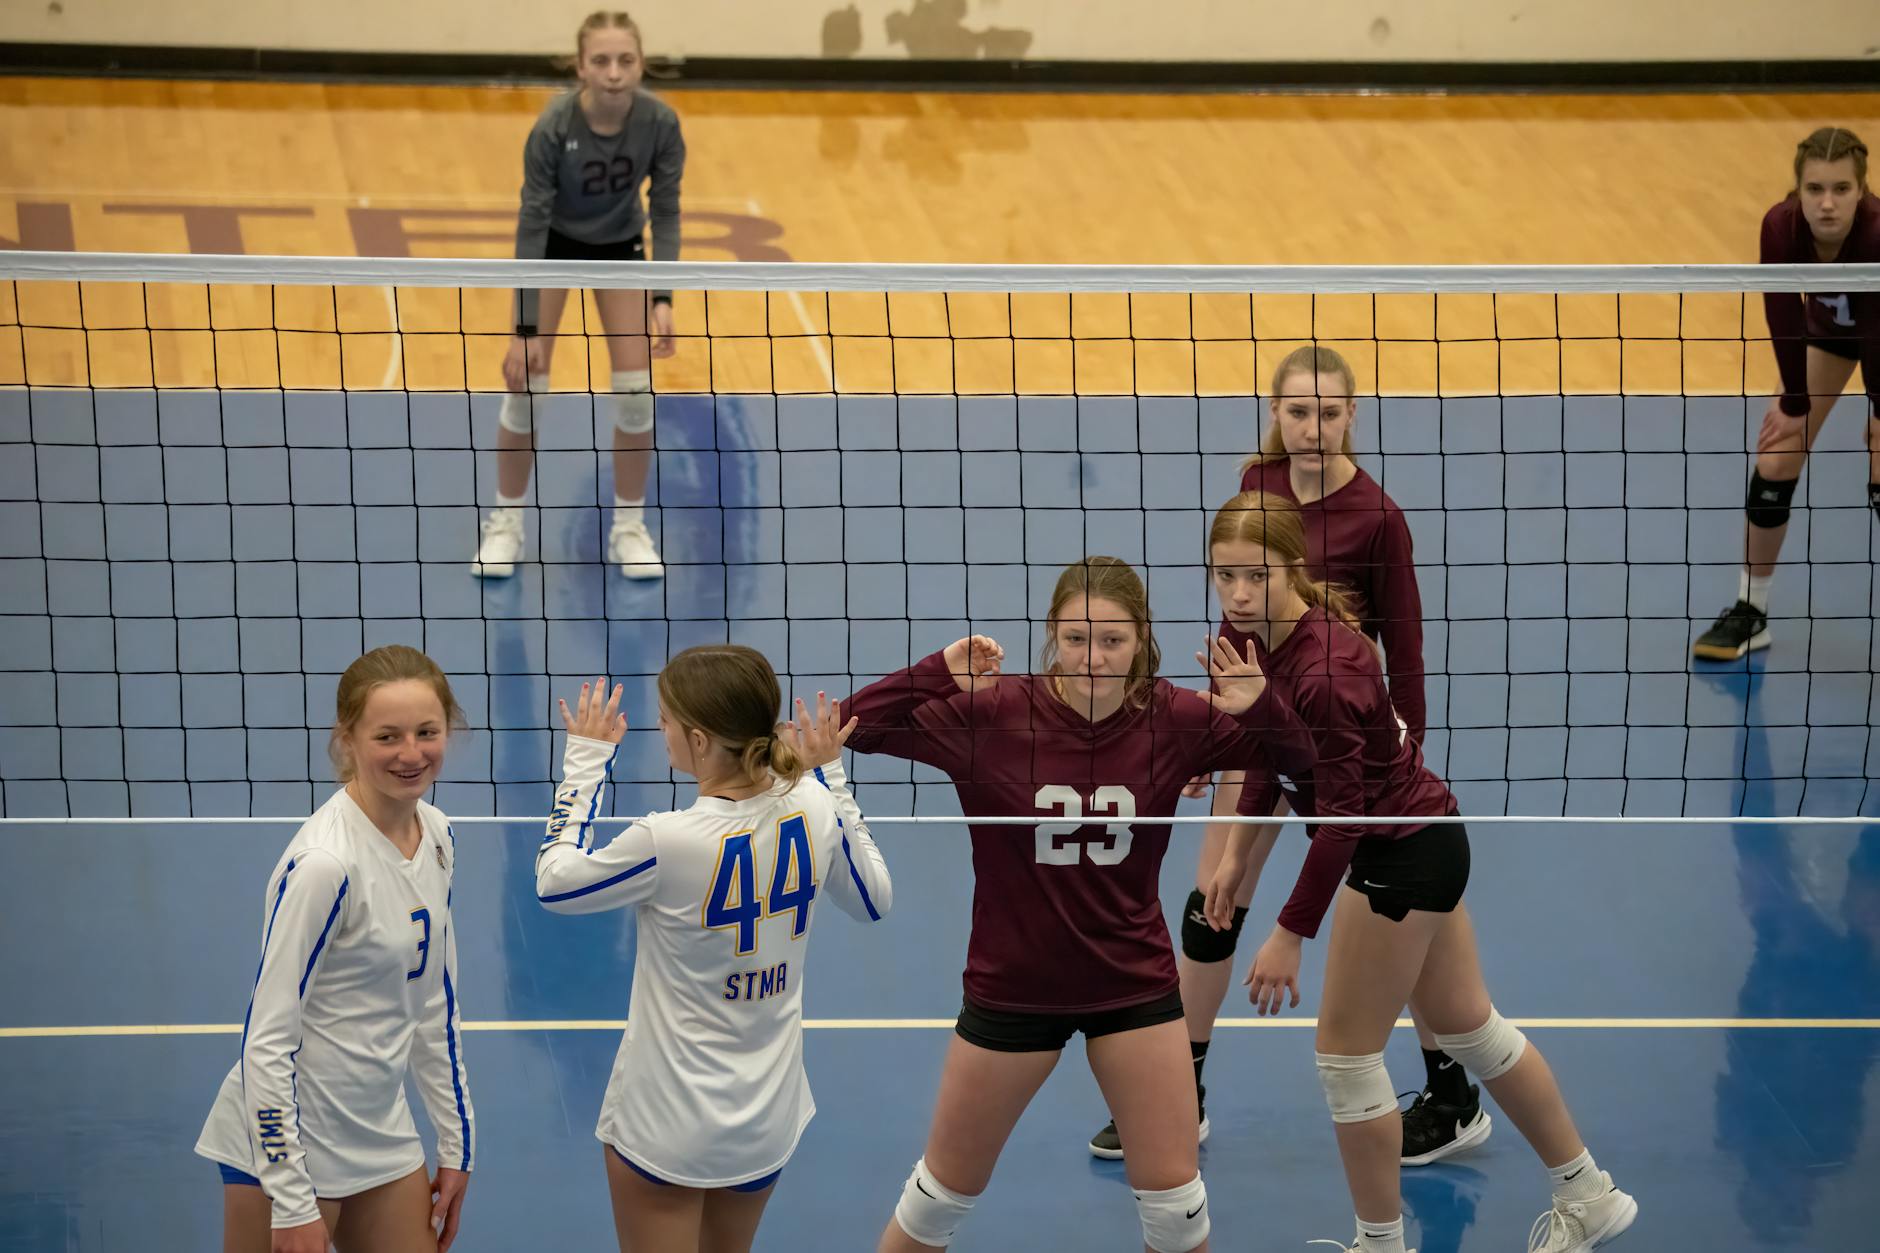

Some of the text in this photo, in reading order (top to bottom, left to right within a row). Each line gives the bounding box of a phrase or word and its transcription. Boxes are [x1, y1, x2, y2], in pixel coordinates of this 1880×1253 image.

[580, 155, 634, 197] 22
[1034, 784, 1137, 866] 23
[702, 811, 818, 956] 44
[406, 904, 432, 982] 3
[723, 962, 788, 1001] STMA
[257, 1108, 289, 1163] STMA
